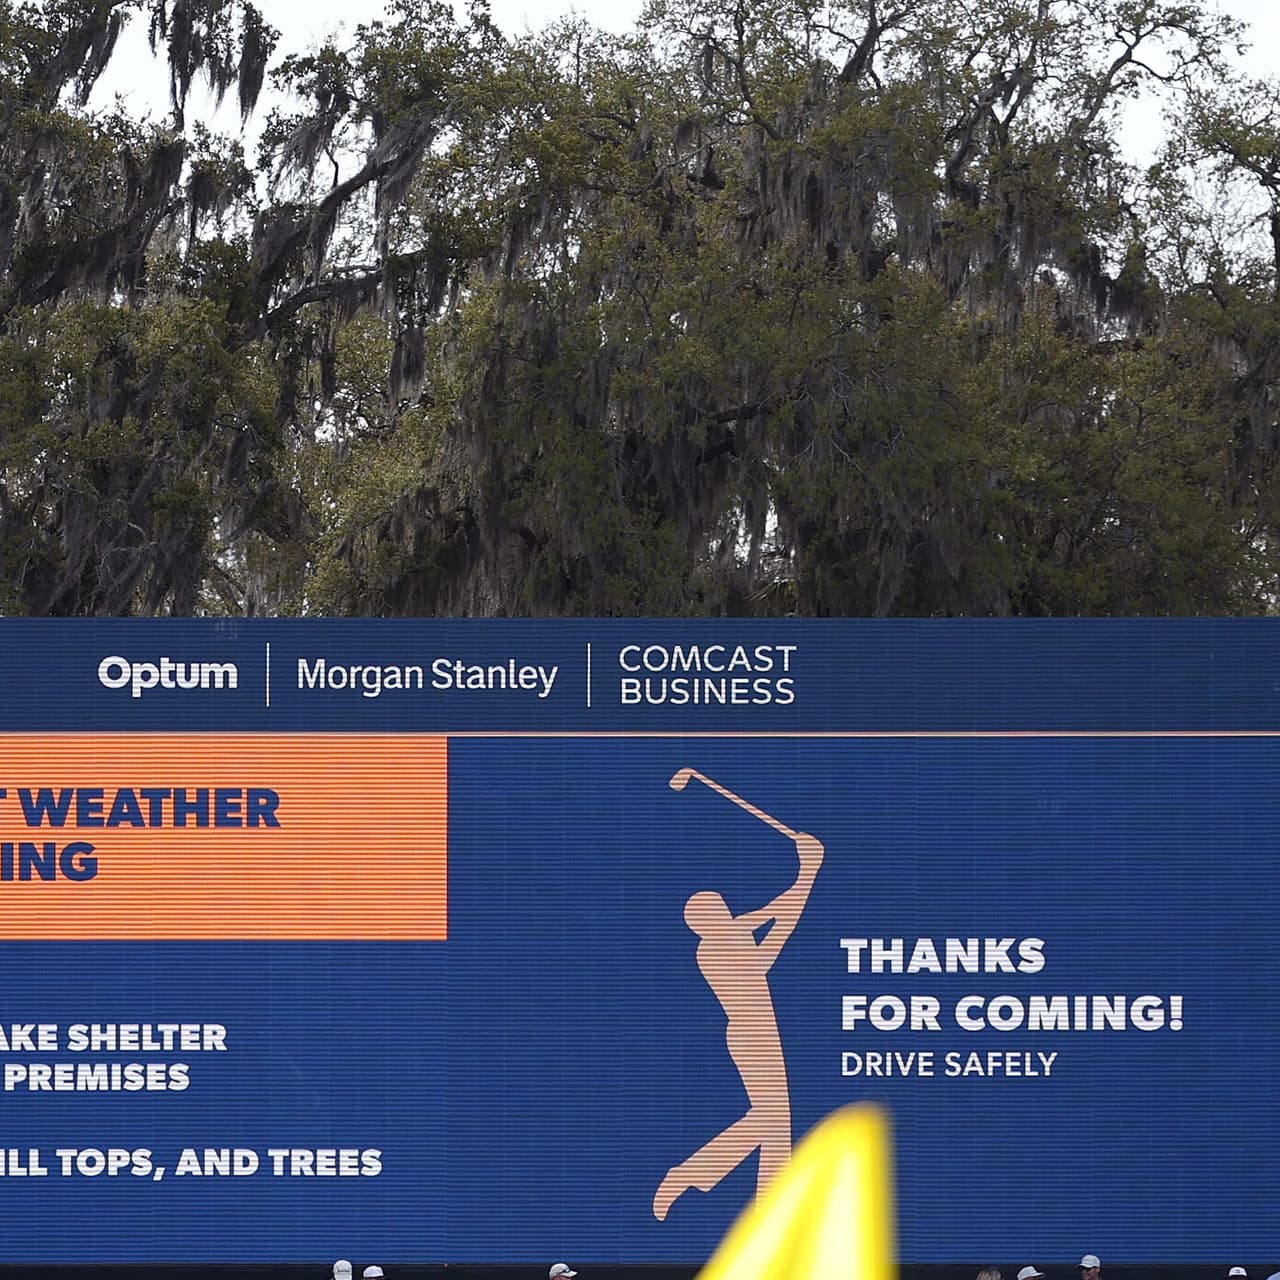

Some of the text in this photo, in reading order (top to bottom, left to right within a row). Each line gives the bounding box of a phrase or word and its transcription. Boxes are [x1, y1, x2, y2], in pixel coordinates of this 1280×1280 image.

[619, 645, 797, 672] COMCAST
[97, 655, 239, 698] Optum
[297, 657, 559, 698] Morgan Stanley
[620, 678, 796, 705] BUSINESS
[17, 787, 281, 829] WEATHER
[840, 937, 1046, 974] THANKS
[841, 994, 1183, 1032] FOR COMING!
[67, 1023, 228, 1051] SHELTER
[4, 1063, 190, 1091] PREMISES
[841, 1051, 1058, 1077] DRIVE SAFELY
[55, 1148, 166, 1182] TOPS,
[174, 1148, 260, 1177] AND
[267, 1148, 383, 1177] TREES
